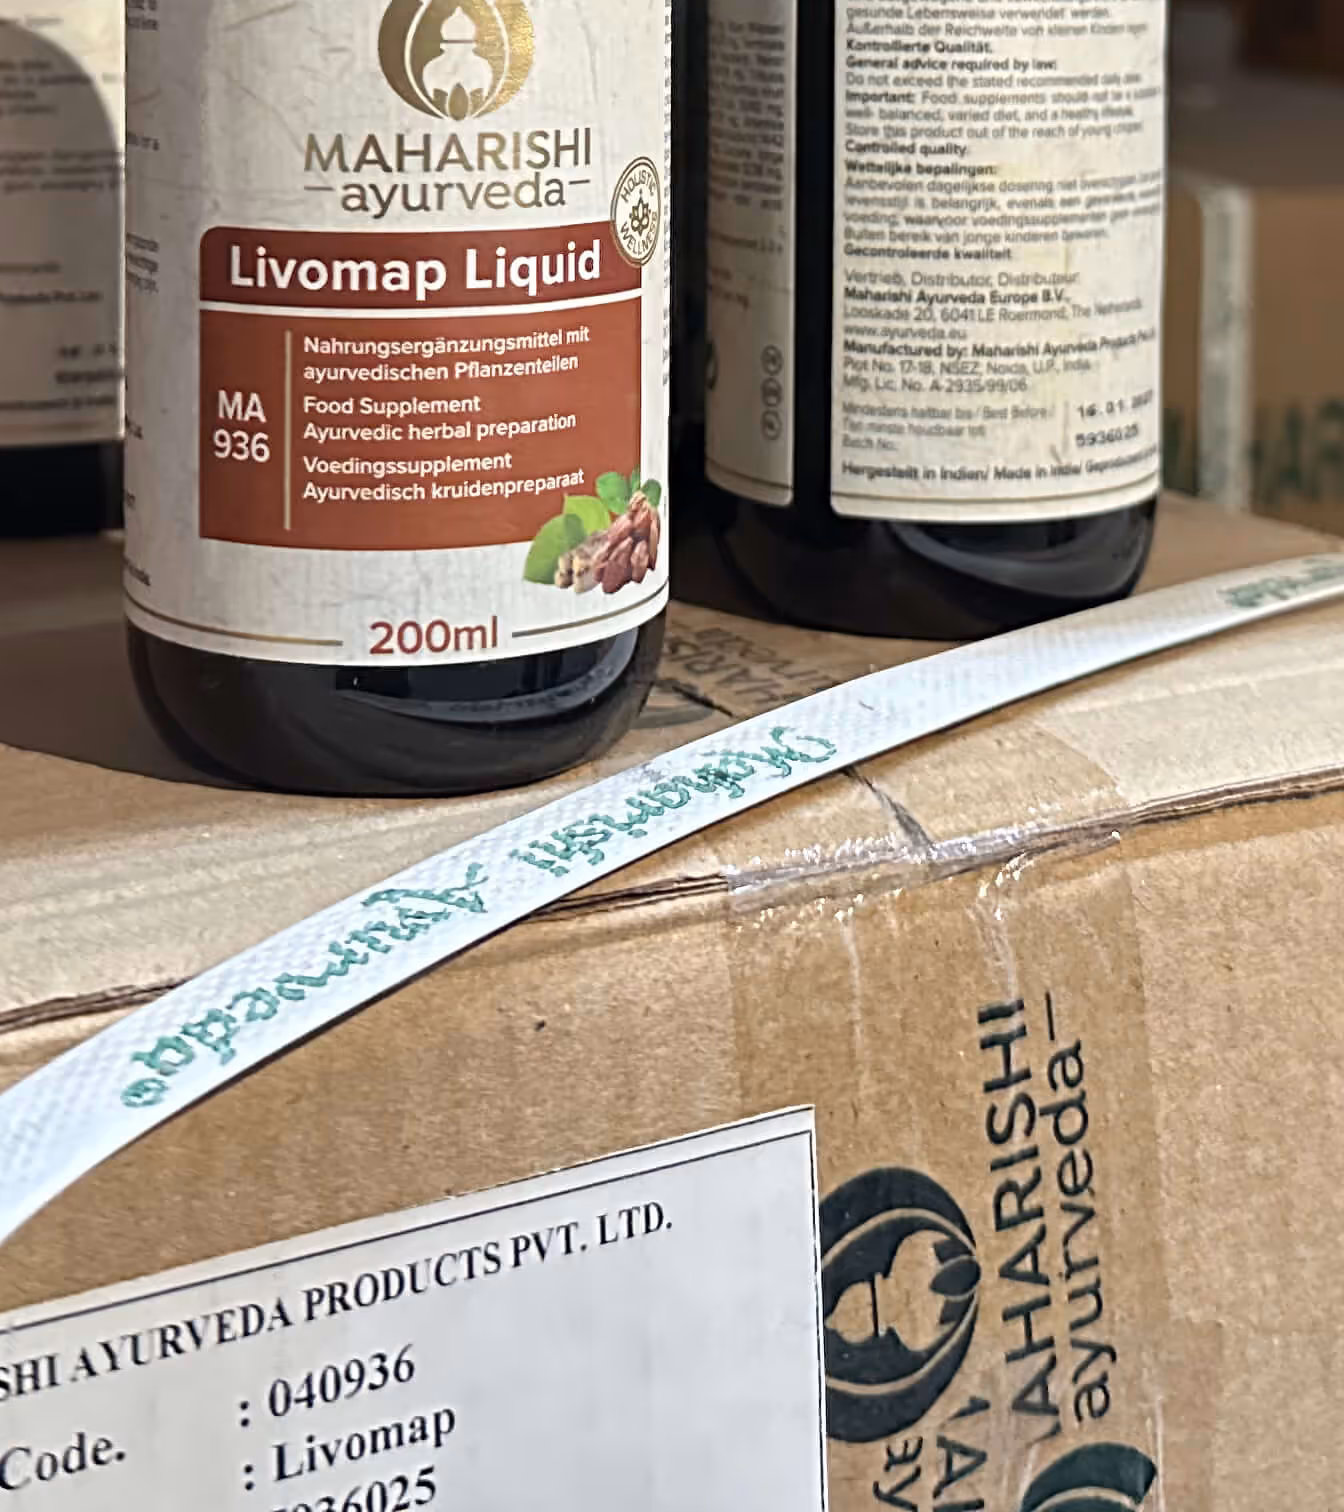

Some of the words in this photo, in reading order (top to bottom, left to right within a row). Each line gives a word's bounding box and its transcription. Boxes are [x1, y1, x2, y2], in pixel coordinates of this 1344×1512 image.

[1013, 59, 1029, 72] by
[303, 127, 592, 174] MAHARISHI
[340, 172, 566, 220] ayurveda
[230, 245, 447, 303] Livomap
[465, 240, 602, 299] Liquid
[916, 290, 985, 306] Ayurveda
[303, 328, 563, 359] Nahrungsergänzungsmittel
[566, 326, 590, 346] mit
[303, 360, 449, 383] ayurvedischen
[454, 354, 579, 380] Pflanzenteilen
[218, 392, 266, 423] MA
[303, 396, 354, 415] Food
[360, 395, 481, 418] Supplement
[213, 430, 270, 464] 936
[303, 422, 403, 445] Ayurvedic
[408, 420, 471, 440] herbal
[477, 412, 577, 443] preparation
[303, 452, 513, 480] Voedingssupplement
[303, 481, 427, 504] Ayurvedisch
[431, 468, 584, 503] kruidenpreparaat
[369, 616, 498, 656] 200ml
[978, 998, 1062, 1438] AHARISHI
[1039, 1039, 1117, 1423] ayurveda
[70, 1302, 292, 1383] AYURVEDA
[303, 1241, 502, 1323] PRODUCTS
[510, 1221, 587, 1272] PVT.
[598, 1201, 673, 1247] LTD.
[268, 1343, 415, 1417] 040936
[273, 1407, 456, 1482] Livomap
[271, 1465, 437, 1512] 6025
